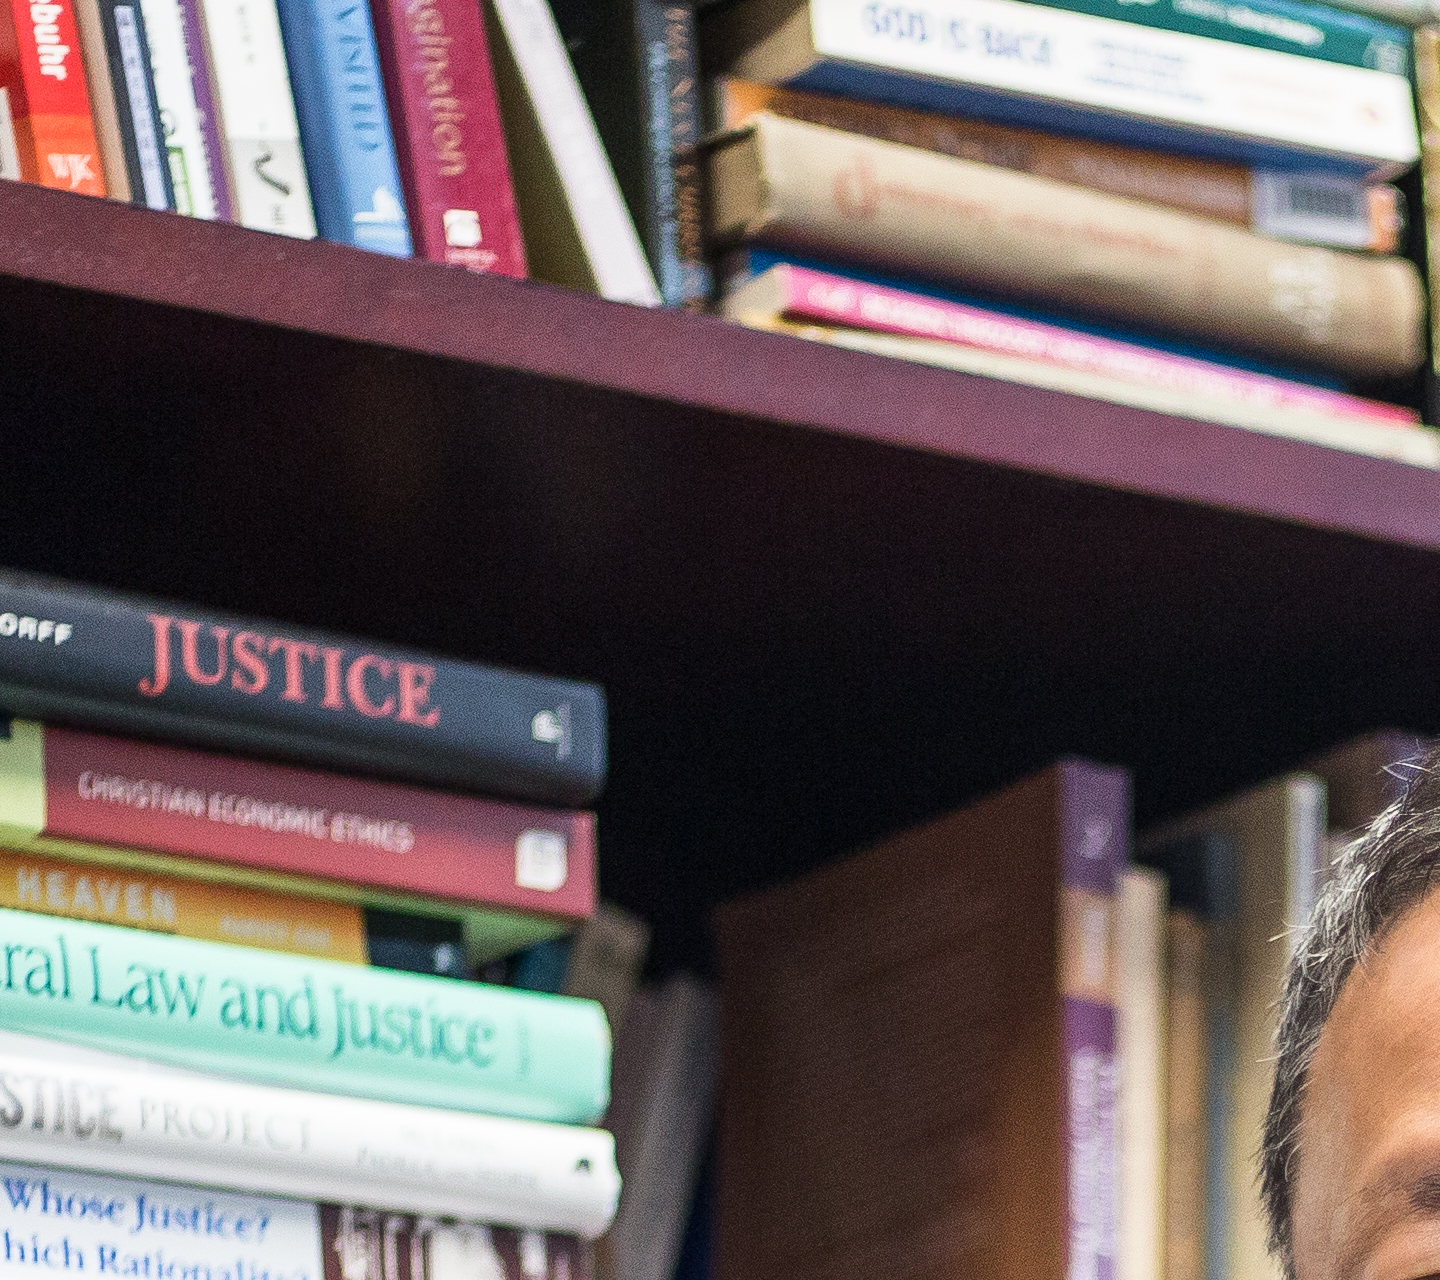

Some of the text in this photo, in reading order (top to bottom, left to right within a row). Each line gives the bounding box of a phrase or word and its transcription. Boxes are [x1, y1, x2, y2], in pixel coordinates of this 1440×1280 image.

[28, 0, 69, 81] buhr
[139, 613, 442, 728] JUSTICE
[17, 867, 177, 925] HEAVEN
[88, 941, 208, 1020] Law
[219, 972, 319, 1041] and
[330, 980, 498, 1067] Justice
[139, 1097, 313, 1152] PROJECT
[2, 1175, 271, 1242] Whose Justice?
